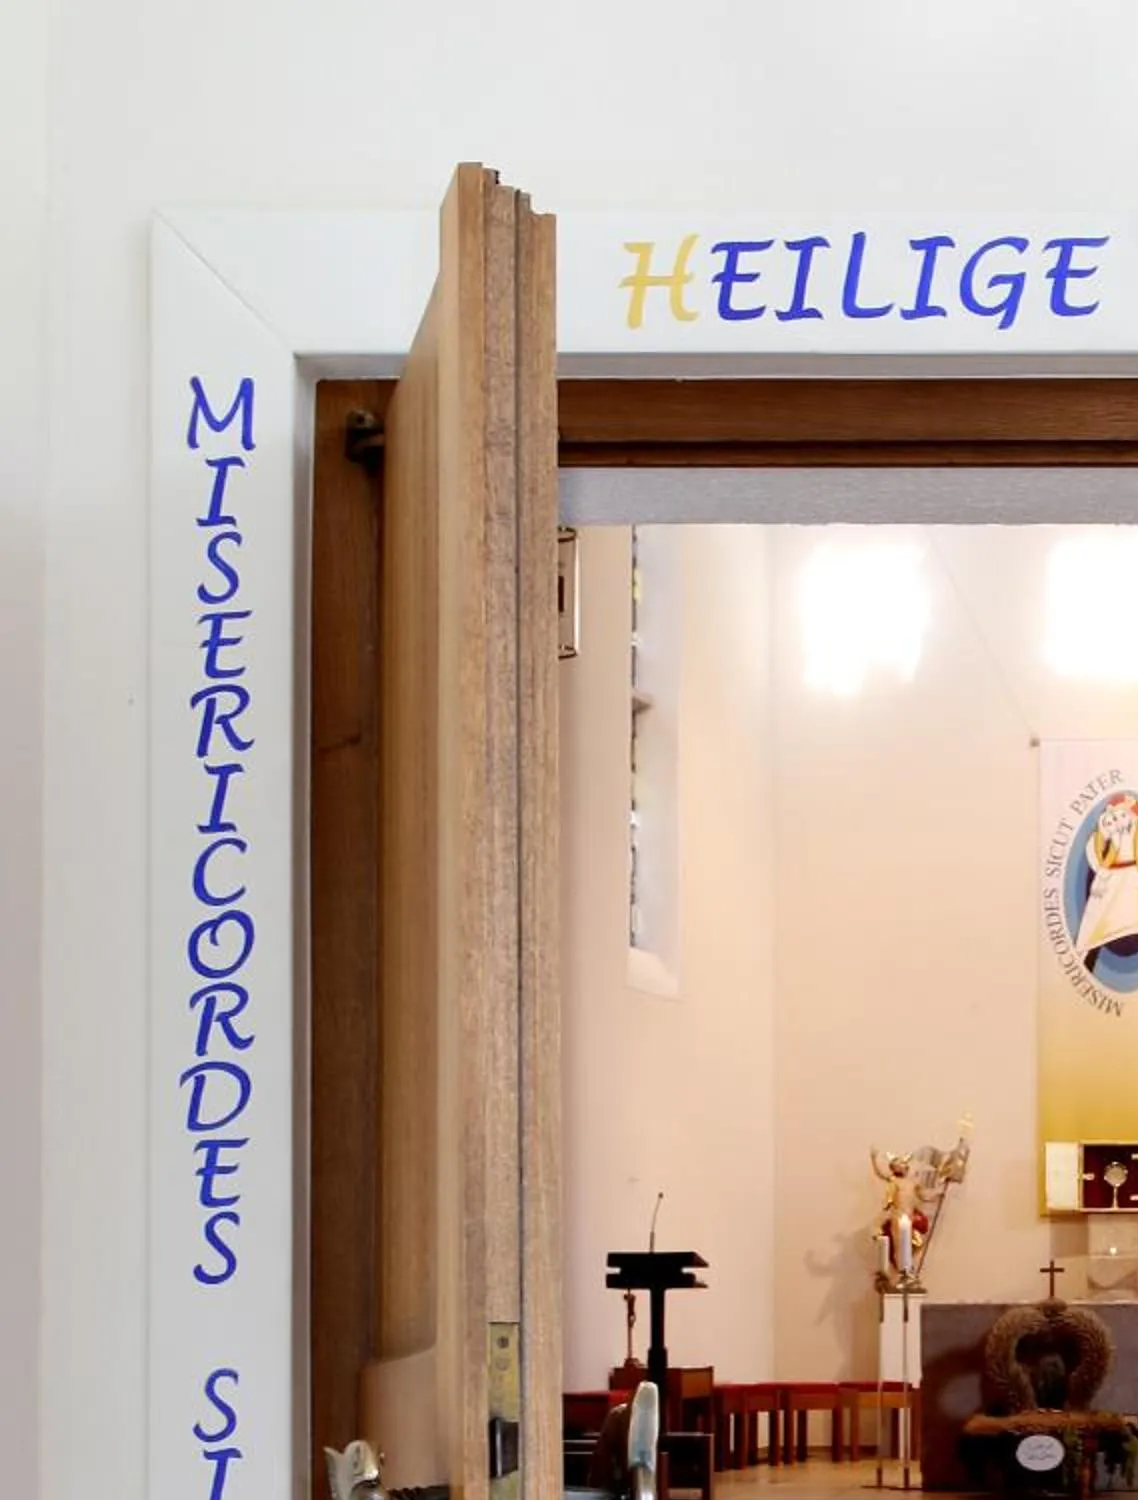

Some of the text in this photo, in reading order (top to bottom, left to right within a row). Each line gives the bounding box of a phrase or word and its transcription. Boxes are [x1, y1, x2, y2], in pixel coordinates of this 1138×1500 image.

[619, 232, 1110, 330] HEILIGE
[181, 377, 256, 1286] MISERICORDES
[1043, 768, 1124, 1017] MISERICORDES SICUT PATER
